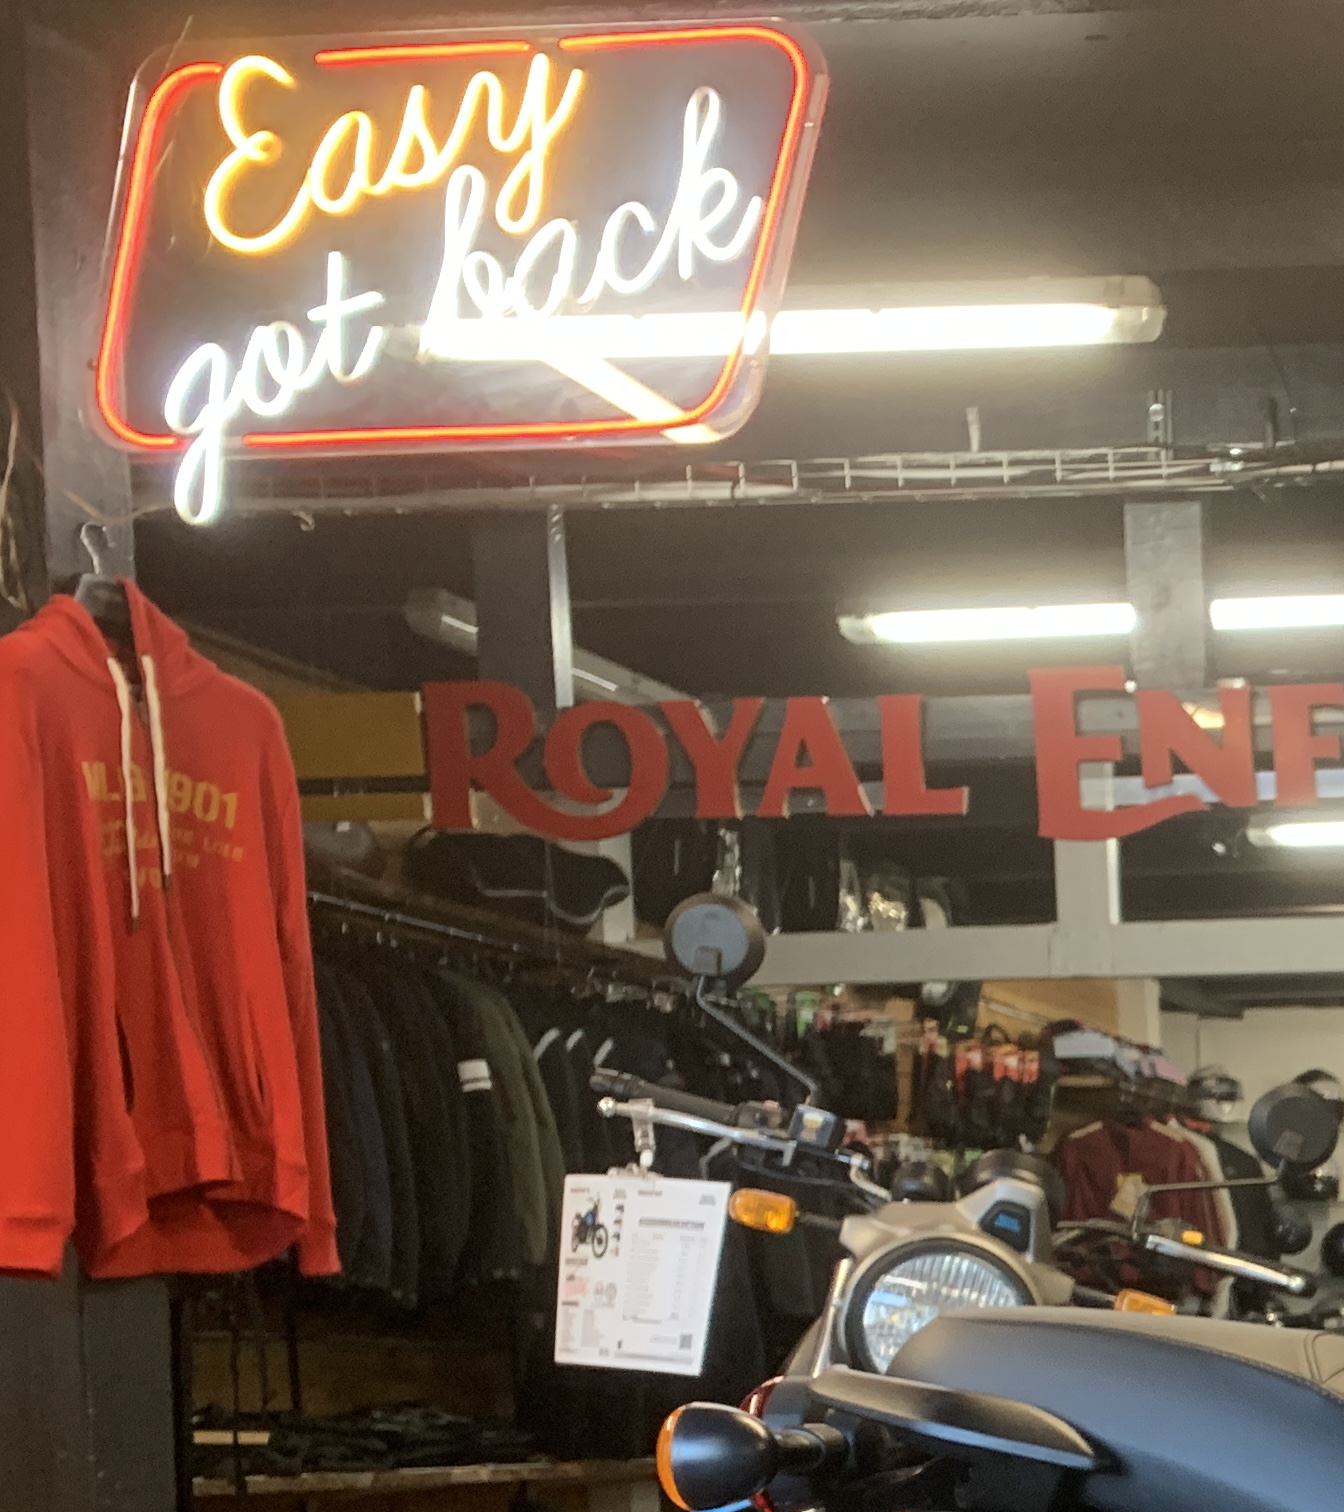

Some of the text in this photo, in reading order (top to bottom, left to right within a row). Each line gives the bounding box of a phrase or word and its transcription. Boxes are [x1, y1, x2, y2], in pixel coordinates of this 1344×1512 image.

[203, 52, 587, 255] Easy
[162, 84, 764, 527] got back
[422, 680, 969, 842] ROYAL
